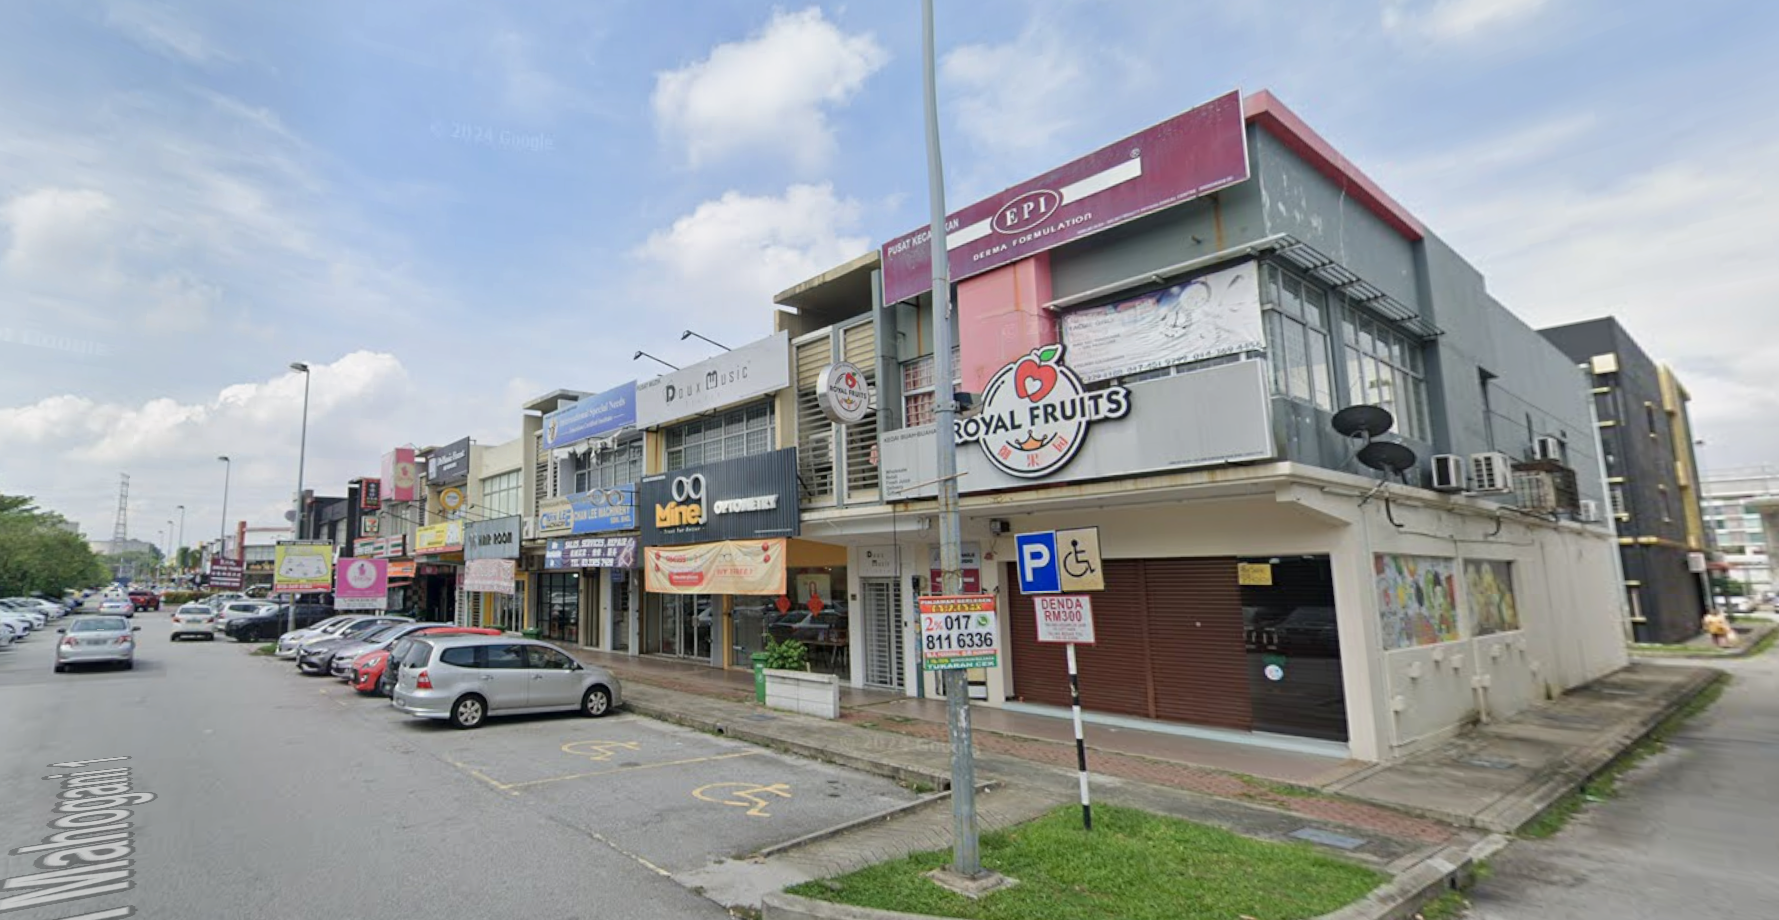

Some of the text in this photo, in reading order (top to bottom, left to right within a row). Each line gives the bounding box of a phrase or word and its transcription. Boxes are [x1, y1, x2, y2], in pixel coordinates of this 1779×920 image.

[1004, 196, 1048, 227] EPI
[887, 240, 911, 257] PUSAT
[973, 244, 1008, 262] DERMA
[829, 385, 867, 400] ROYAL FRUITS
[608, 398, 626, 409] Needs
[953, 389, 1123, 439] ROYAL FRUITS
[900, 428, 938, 441] BUAH-BUAHA
[713, 493, 779, 515] OPTOMETRY
[588, 508, 598, 520] LEE
[478, 531, 514, 546] HAIR ROOM
[1022, 542, 1051, 583] P
[1041, 598, 1084, 610] DENDA
[944, 614, 971, 631] 017
[1044, 610, 1083, 622] RM300
[926, 631, 994, 650] 811 6336
